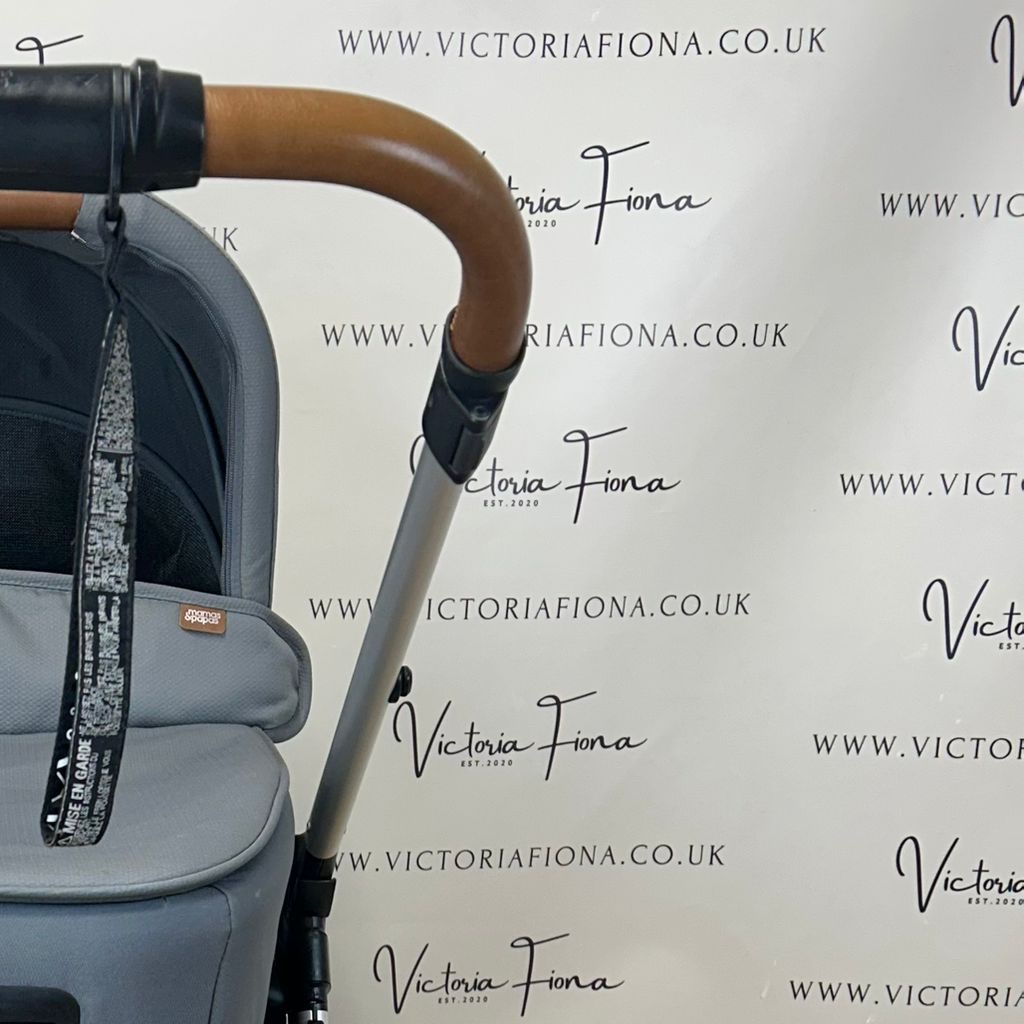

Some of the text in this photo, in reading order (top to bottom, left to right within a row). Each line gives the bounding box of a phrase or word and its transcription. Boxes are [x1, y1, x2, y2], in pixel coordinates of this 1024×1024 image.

[338, 27, 826, 58] WWW.VICTORIAFIONA.CO.UK
[580, 141, 712, 246] Fiona
[528, 219, 556, 228] 2020
[563, 427, 681, 524] Fiona
[484, 499, 538, 507] EST.2020
[393, 691, 648, 781] Victoria Fiona
[74, 738, 93, 780] GARDE
[461, 759, 512, 767] EST.2020
[71, 783, 85, 801] EN
[63, 802, 82, 834] MISE
[373, 933, 625, 1017] Victoria Fiona
